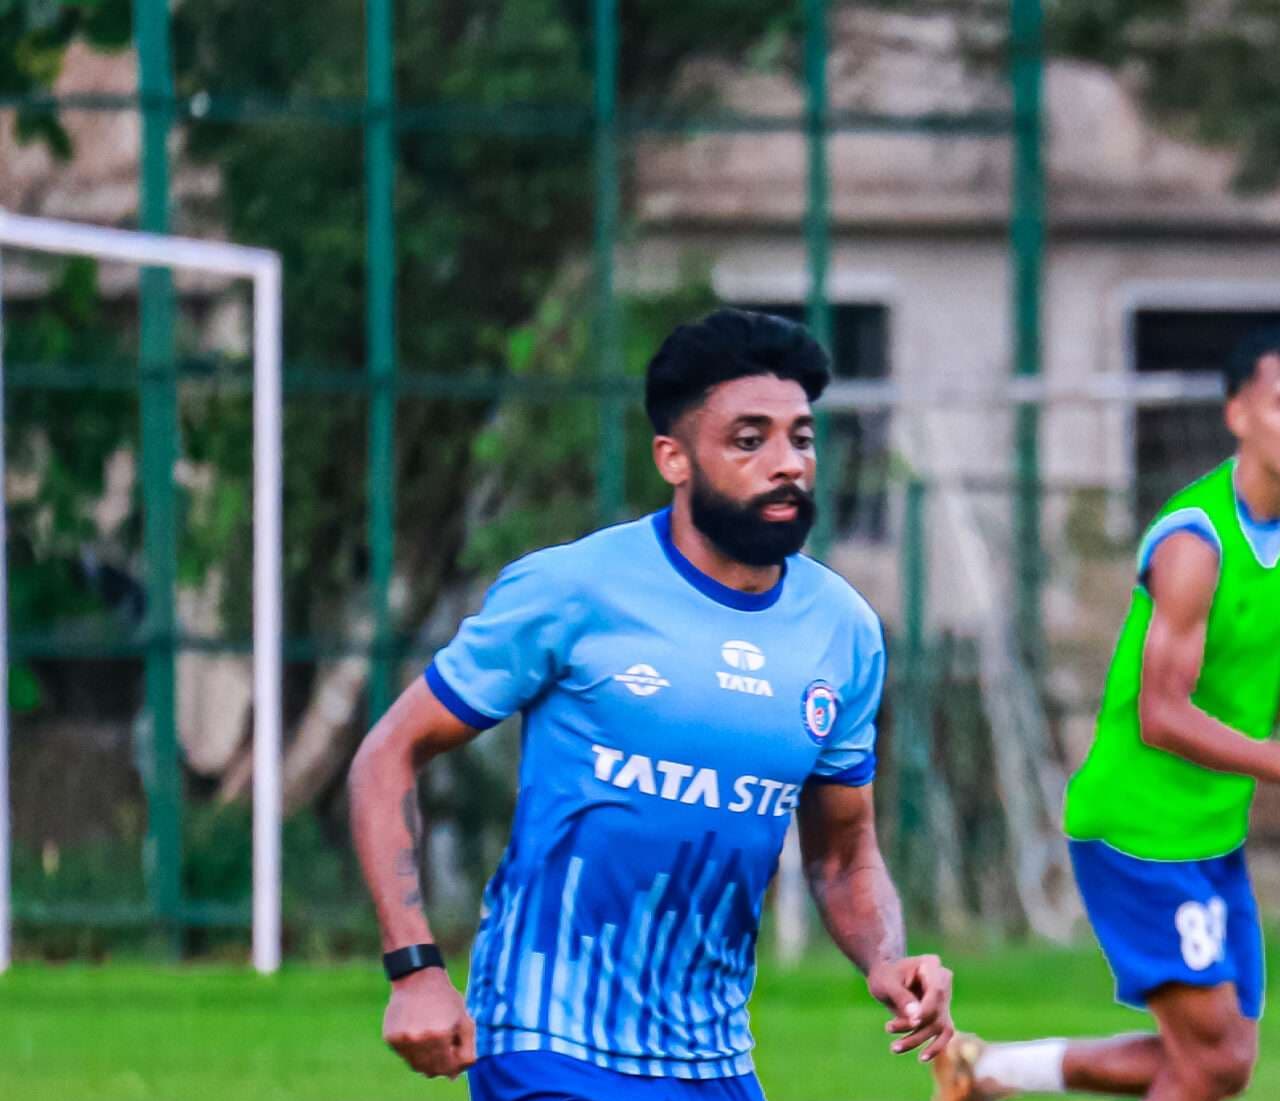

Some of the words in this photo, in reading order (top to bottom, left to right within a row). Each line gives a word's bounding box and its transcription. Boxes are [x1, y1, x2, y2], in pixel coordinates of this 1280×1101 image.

[715, 671, 773, 697] TATA
[592, 744, 720, 809] TATA
[728, 775, 802, 816] STE
